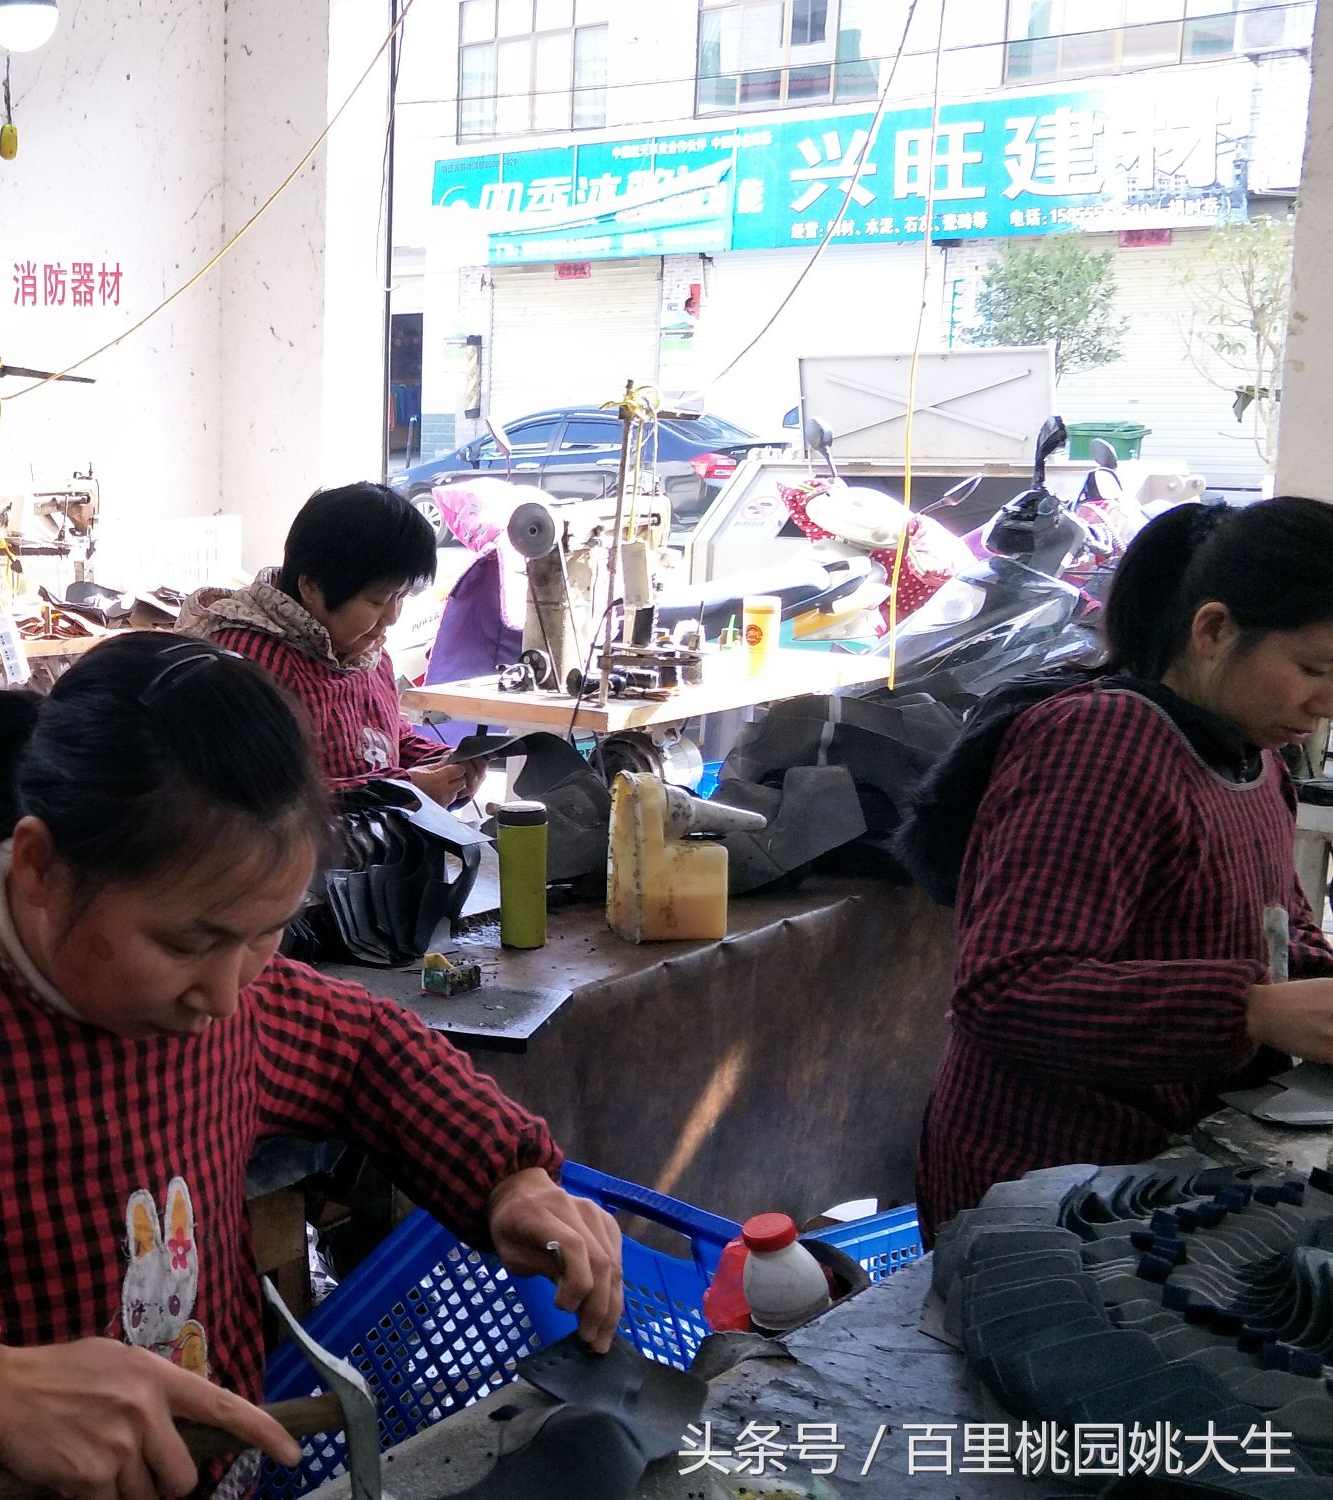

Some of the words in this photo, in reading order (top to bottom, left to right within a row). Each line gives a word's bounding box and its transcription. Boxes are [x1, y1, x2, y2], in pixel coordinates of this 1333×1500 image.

[789, 96, 1233, 214] 兴旺建材
[13, 260, 123, 306] 消防器材
